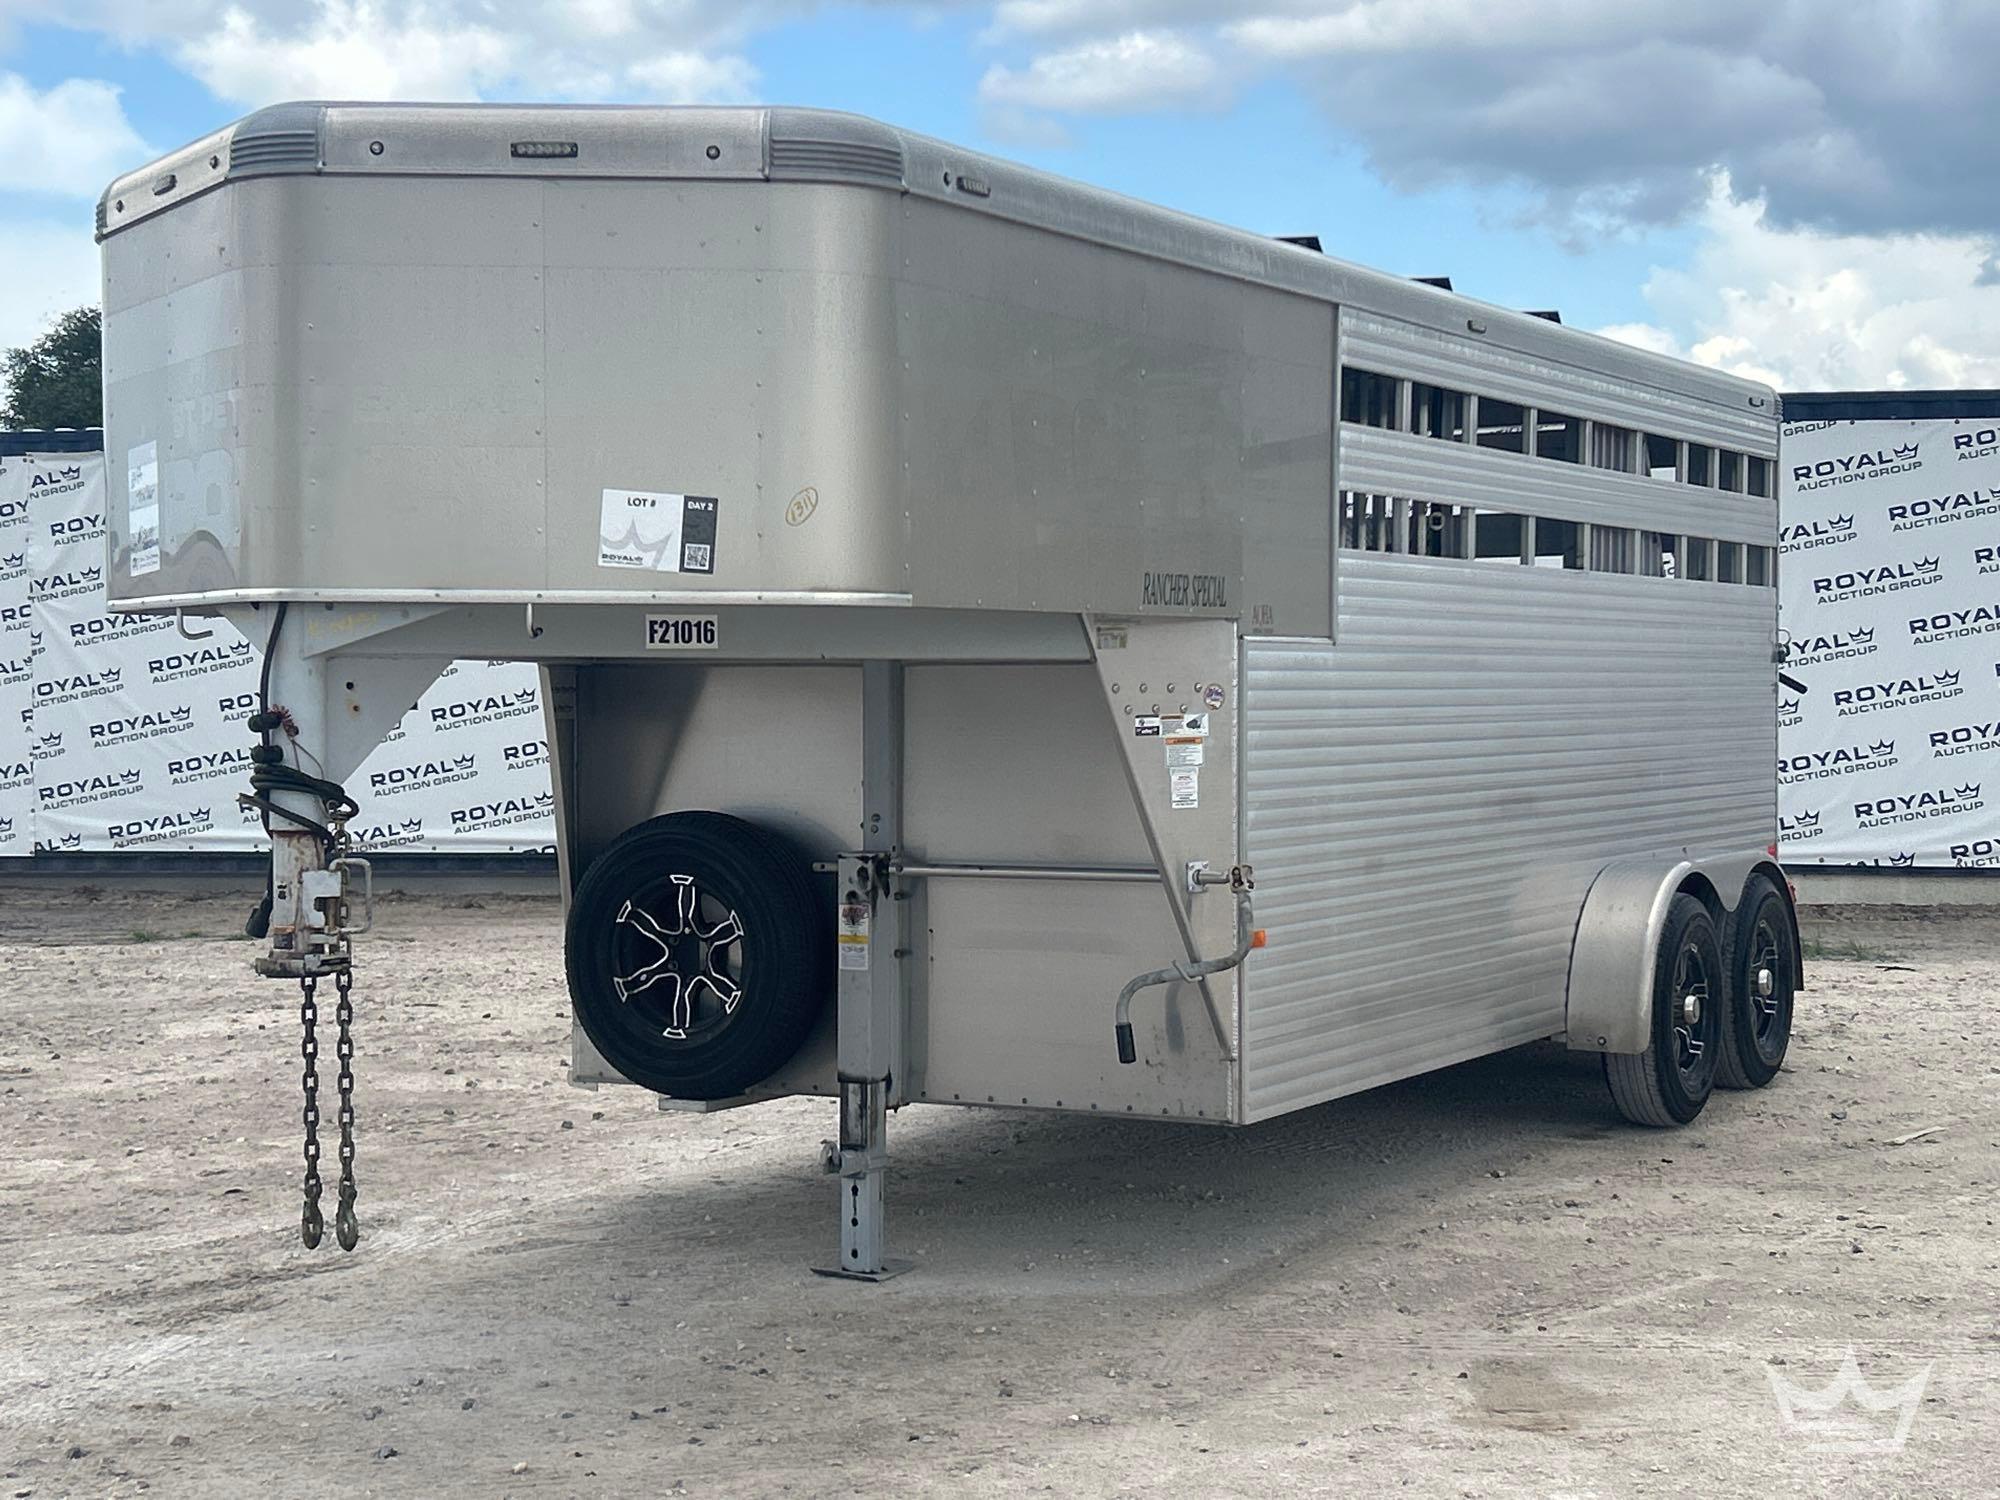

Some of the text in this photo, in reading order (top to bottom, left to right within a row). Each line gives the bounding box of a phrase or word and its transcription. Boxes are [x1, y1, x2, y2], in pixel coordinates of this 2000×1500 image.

[1783, 420, 1837, 437] GROUP
[1793, 451, 1893, 481] ROYAL
[1797, 461, 1922, 492] AUCTION GROUP
[41, 481, 85, 496] GROUP
[627, 497, 648, 507] LOT
[687, 501, 706, 510] DAY
[1888, 491, 1990, 521] ROYAL
[1892, 512, 1962, 532] AUCTION
[1803, 532, 1858, 549] GROUP
[61, 582, 105, 597] GROUP
[1142, 572, 1227, 607] RANCHER SPECIAL
[1813, 563, 1914, 593] ROYAL
[1817, 574, 1943, 605] AUCTION GROUP
[70, 614, 151, 637] ROYAL
[74, 620, 174, 647] AUCTION GROUP
[649, 620, 715, 644] F21016
[1913, 626, 1982, 645] AUCTION
[148, 647, 230, 673] ROYAL
[1823, 645, 1878, 661] GROUP
[152, 656, 254, 684] AUCTION GROUP
[32, 674, 100, 697] OYAL
[81, 683, 124, 699] GROUP
[1833, 677, 1934, 706] ROYAL
[431, 695, 515, 722] ROYAL
[1838, 687, 1964, 717] AUCTION GROUP
[89, 711, 171, 738] ROYAL
[435, 704, 539, 732] AUCTION GROUP
[94, 721, 194, 748] AUCTION GROUP
[168, 748, 249, 774] ROYAL
[370, 760, 454, 787] ROYAL
[1844, 757, 1898, 774] GROUP
[39, 774, 120, 801] ROYAL
[172, 768, 227, 785] AUCTION
[374, 770, 478, 798] AUCTION GROUP
[43, 785, 144, 811] AUCTION GROUP
[450, 797, 534, 824] ROYAL
[1854, 790, 1955, 818] ROYAL
[108, 813, 191, 839] ROYAL
[454, 816, 511, 834] AUCTION
[1858, 801, 1984, 829] AUCTION GROUP
[113, 823, 214, 849] AUCTION GROUP
[381, 834, 425, 849] GROUP
